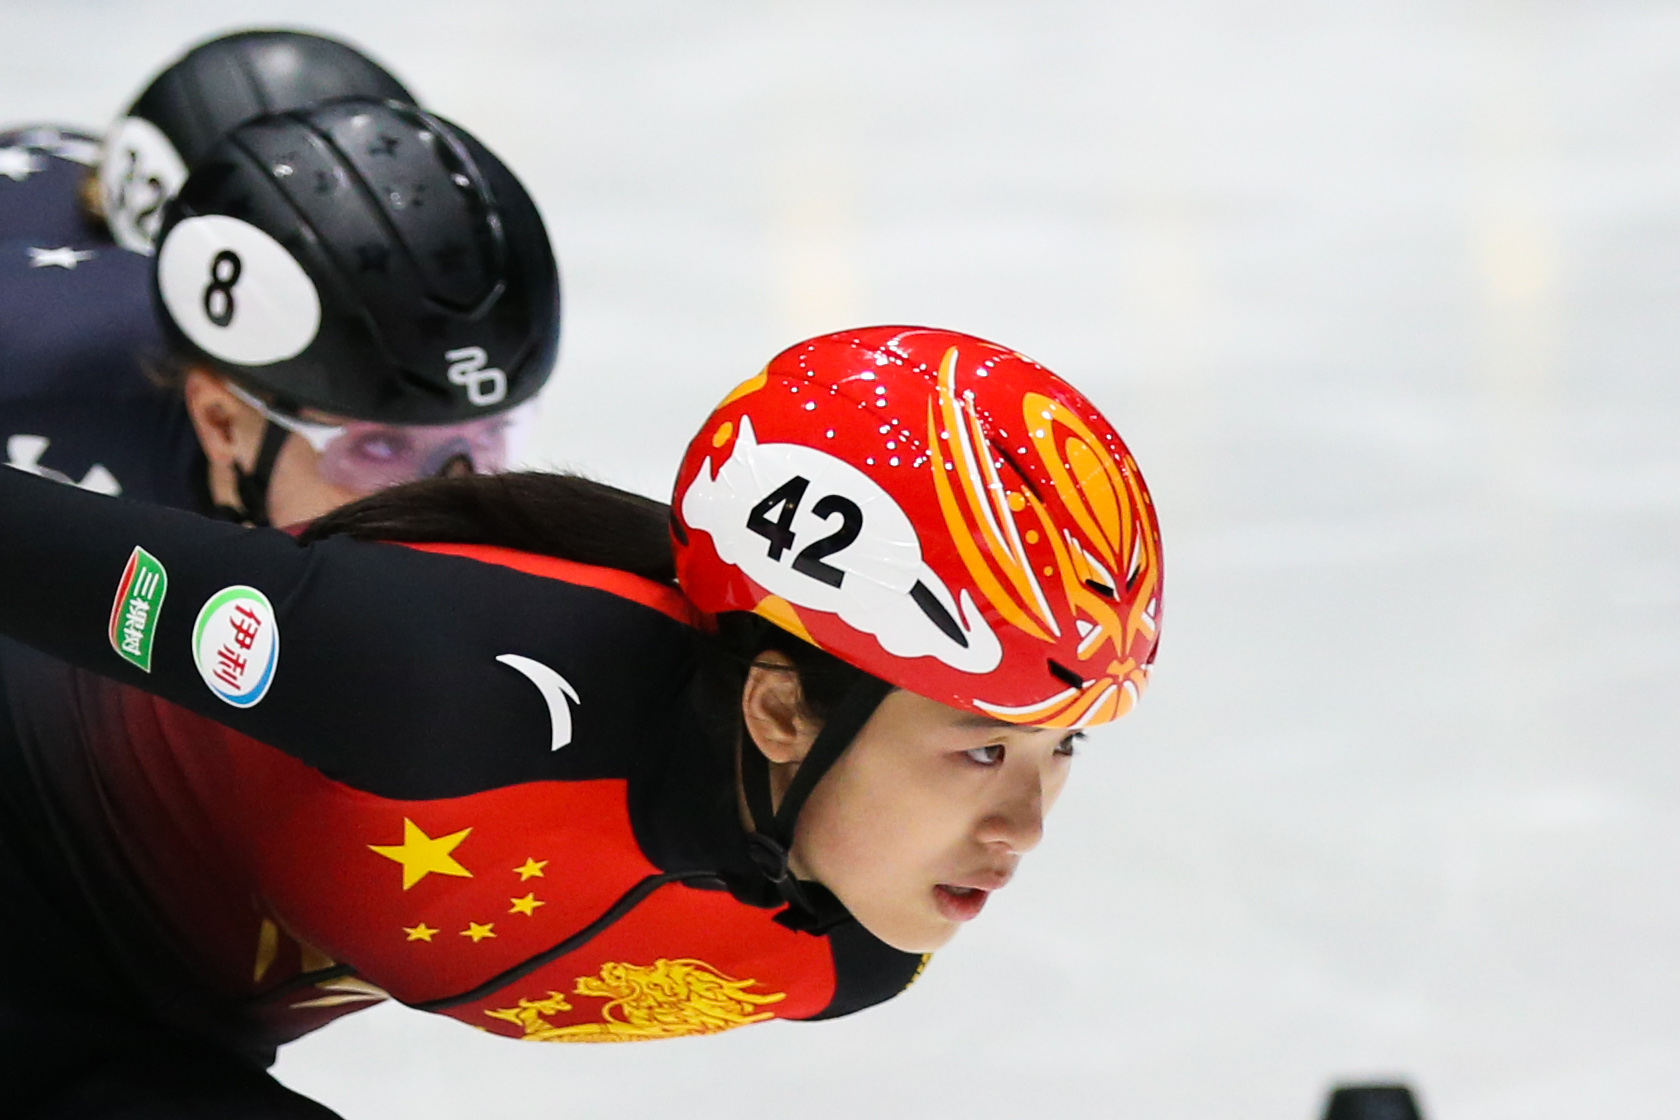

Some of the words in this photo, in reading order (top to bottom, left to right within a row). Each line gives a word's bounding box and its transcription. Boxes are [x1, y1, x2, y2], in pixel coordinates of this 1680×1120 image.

[203, 249, 242, 328] 8
[746, 474, 864, 590] 42
[212, 604, 263, 692] 伊利
